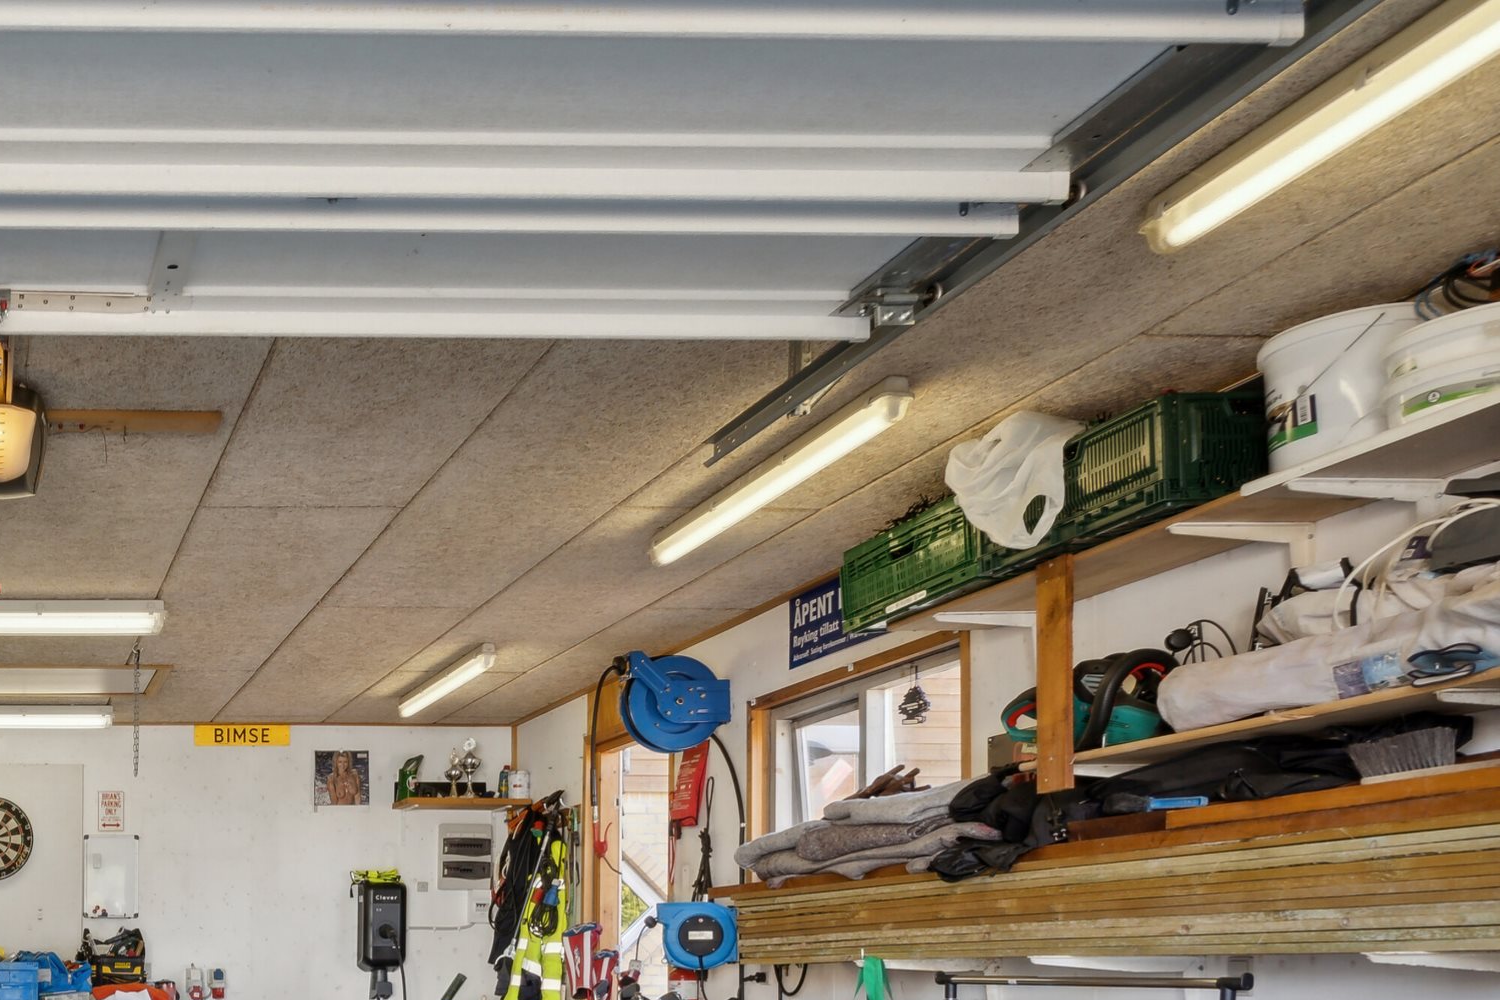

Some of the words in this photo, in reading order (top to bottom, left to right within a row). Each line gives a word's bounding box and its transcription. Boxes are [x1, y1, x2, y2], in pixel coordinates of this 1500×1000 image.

[793, 590, 835, 629] ÅPENT
[793, 629, 819, 648] Røyking
[214, 728, 270, 743] BIMSE
